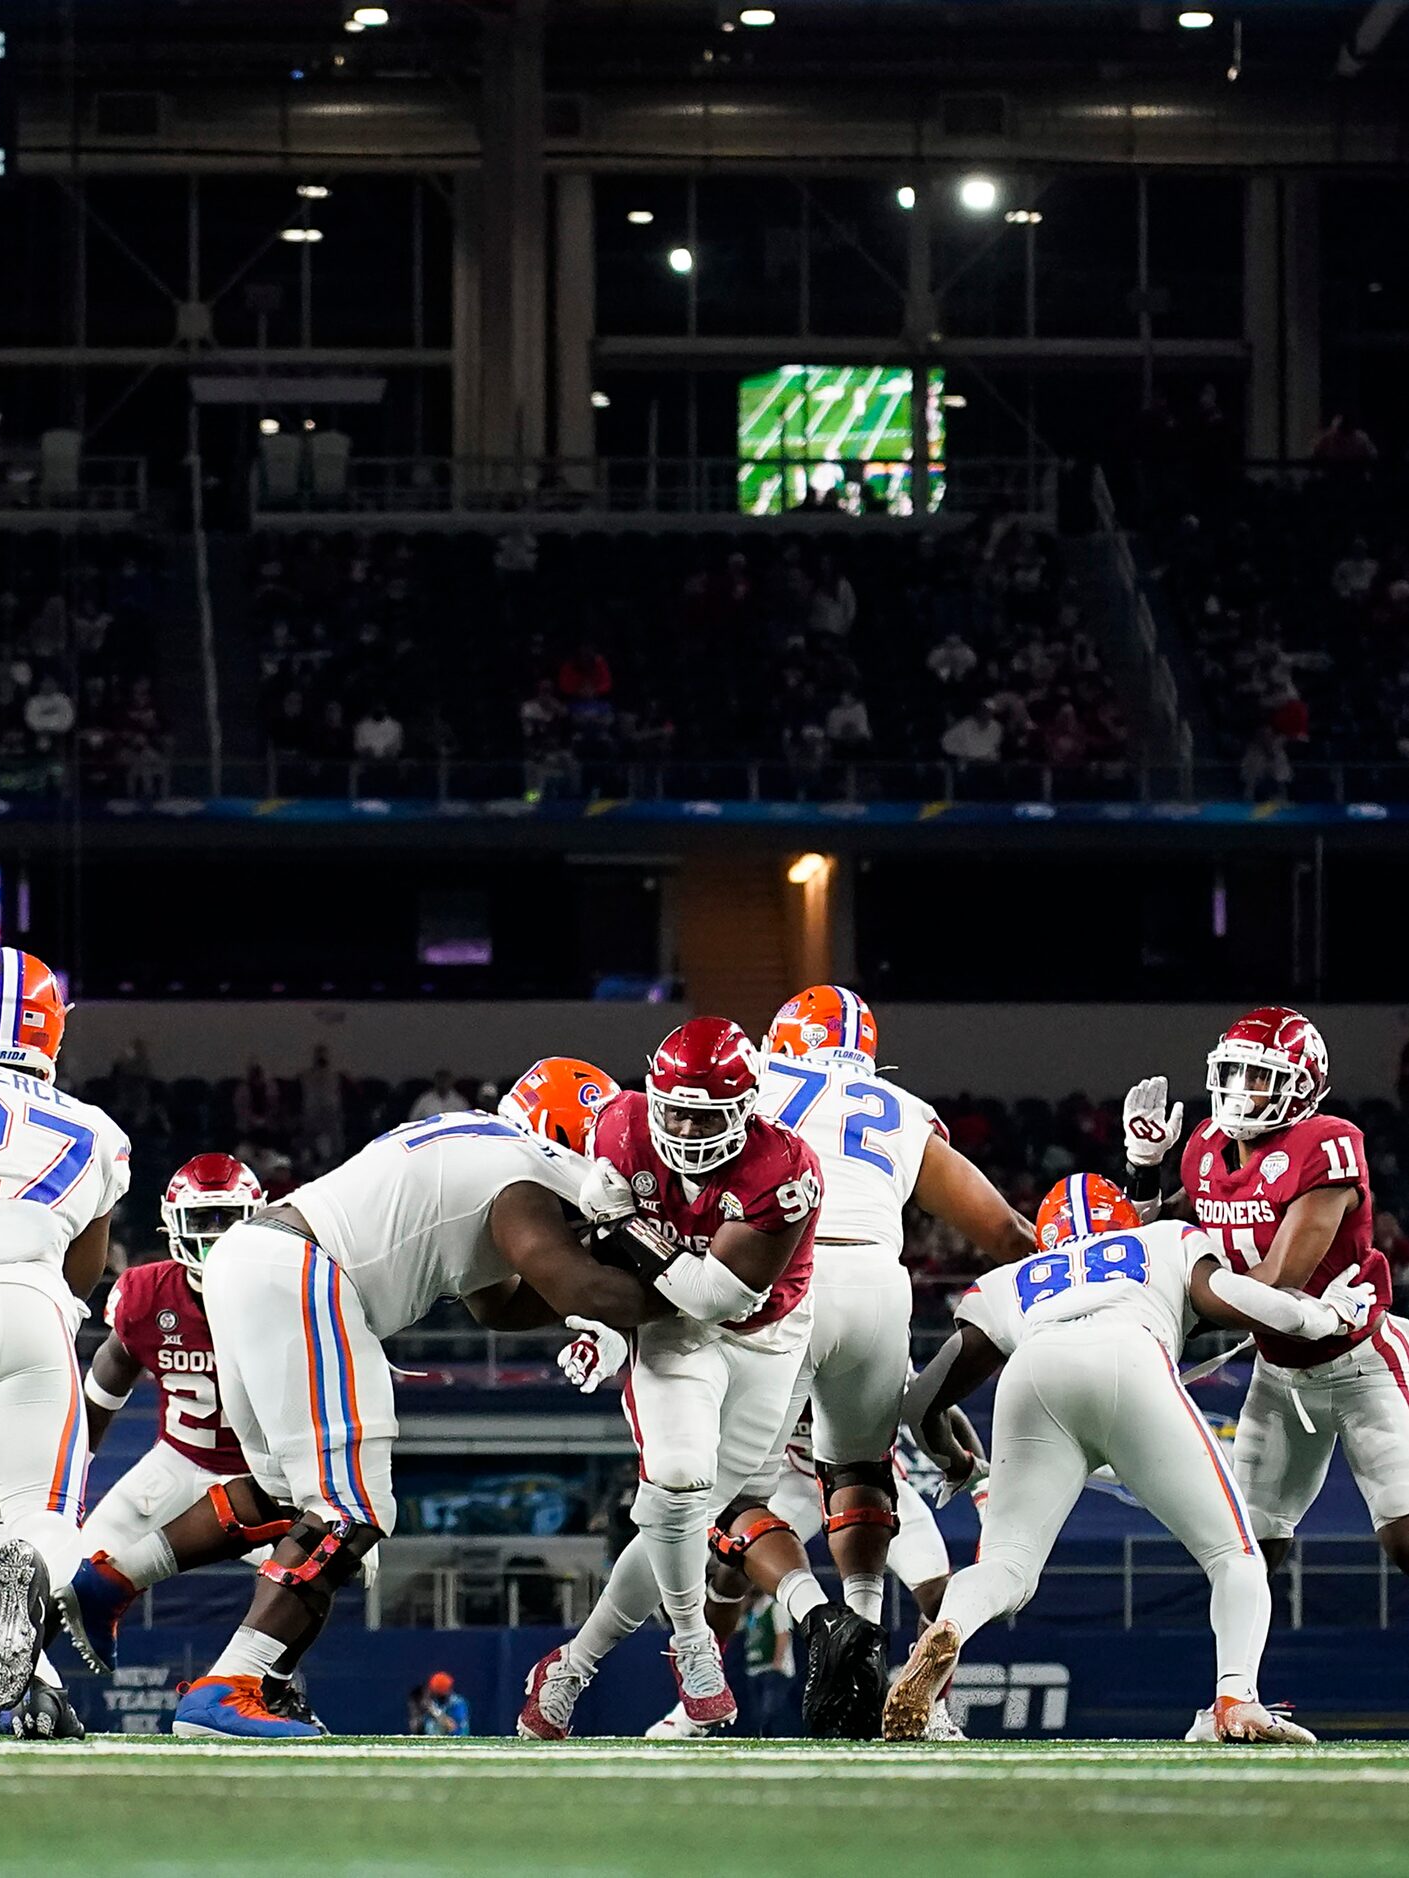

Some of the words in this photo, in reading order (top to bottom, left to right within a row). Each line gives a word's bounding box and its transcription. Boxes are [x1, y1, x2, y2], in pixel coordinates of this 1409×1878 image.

[833, 1050, 865, 1063] FLORIDA
[765, 1061, 904, 1182] 72
[1320, 1136, 1359, 1180] 11
[1195, 1198, 1275, 1225] SOONERS
[160, 1373, 232, 1449] 2
